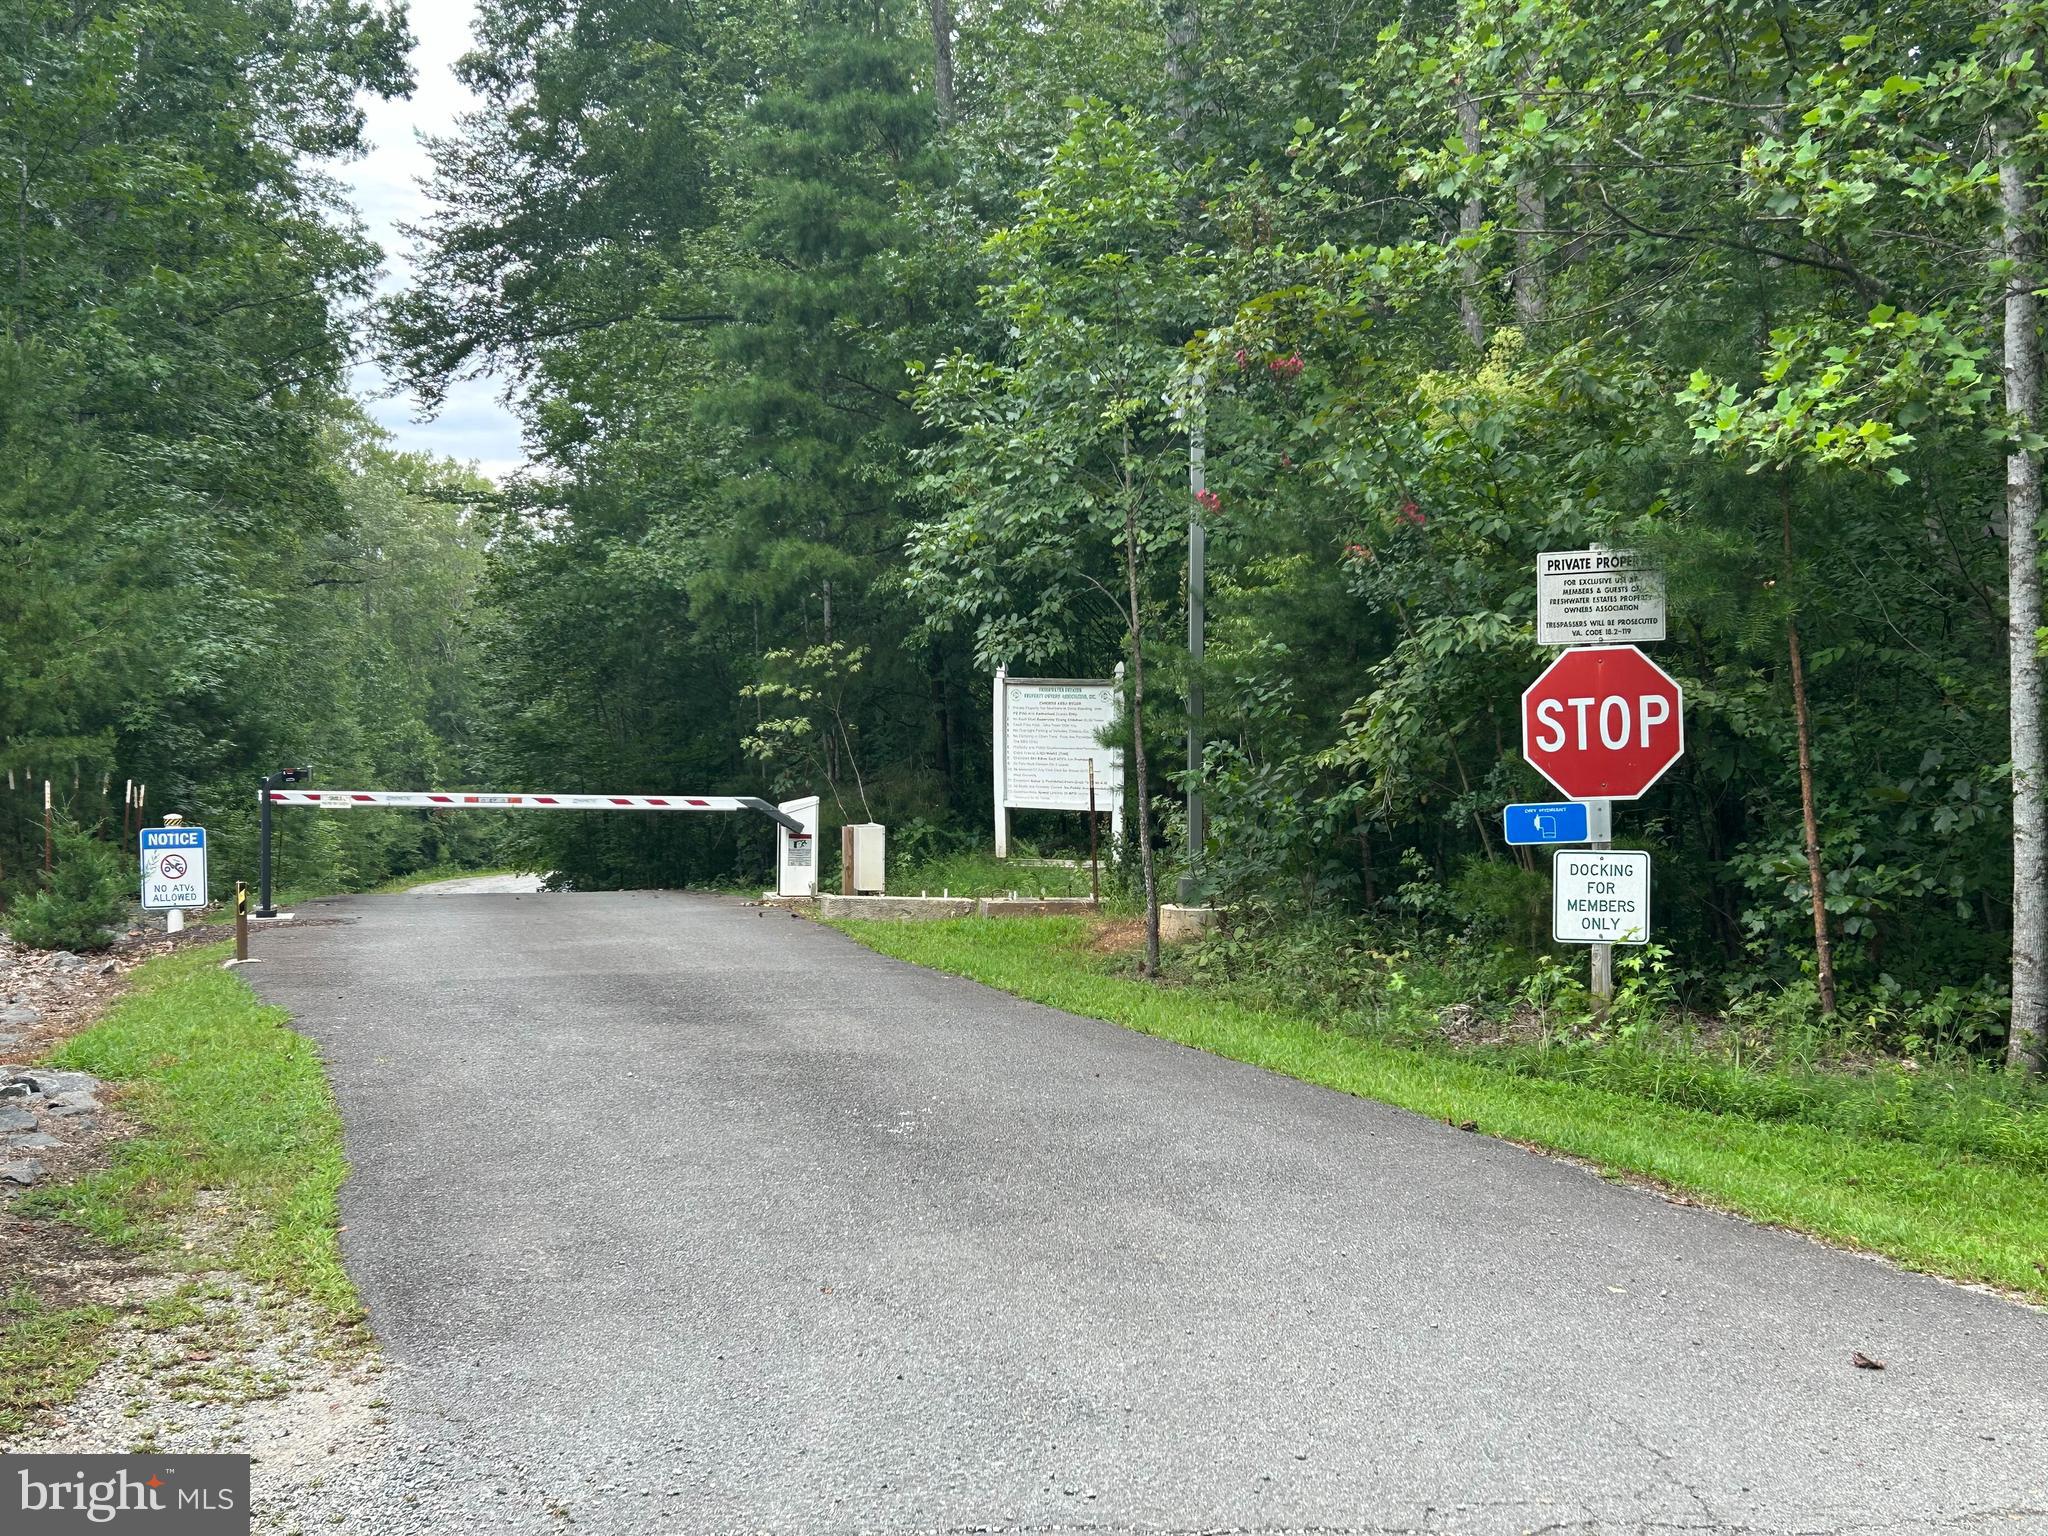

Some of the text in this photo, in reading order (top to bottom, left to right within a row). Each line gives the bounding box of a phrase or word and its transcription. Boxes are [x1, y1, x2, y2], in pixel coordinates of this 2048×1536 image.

[1547, 557, 1591, 571] PRIVATE
[1579, 577, 1612, 586] EXCLUSIVE
[1563, 587, 1594, 595] MEMBERS
[1605, 586, 1628, 594] GUESTS
[1549, 597, 1589, 605] FRESHWATER
[1593, 595, 1618, 603] ESTATES
[1595, 604, 1639, 612] ASSOCIATION
[1546, 620, 1587, 629] TRESPASSERS
[1618, 618, 1658, 626] PROSECUTED
[1536, 694, 1670, 753] STOP
[148, 832, 199, 846] NOTICE
[1569, 863, 1634, 877] DOCKING
[154, 884, 195, 893] NO ATVs
[1587, 881, 1615, 894] FOR
[152, 893, 197, 902] ALLOWED
[1567, 899, 1635, 913] MEMBERS
[1581, 917, 1621, 930] ONLY
